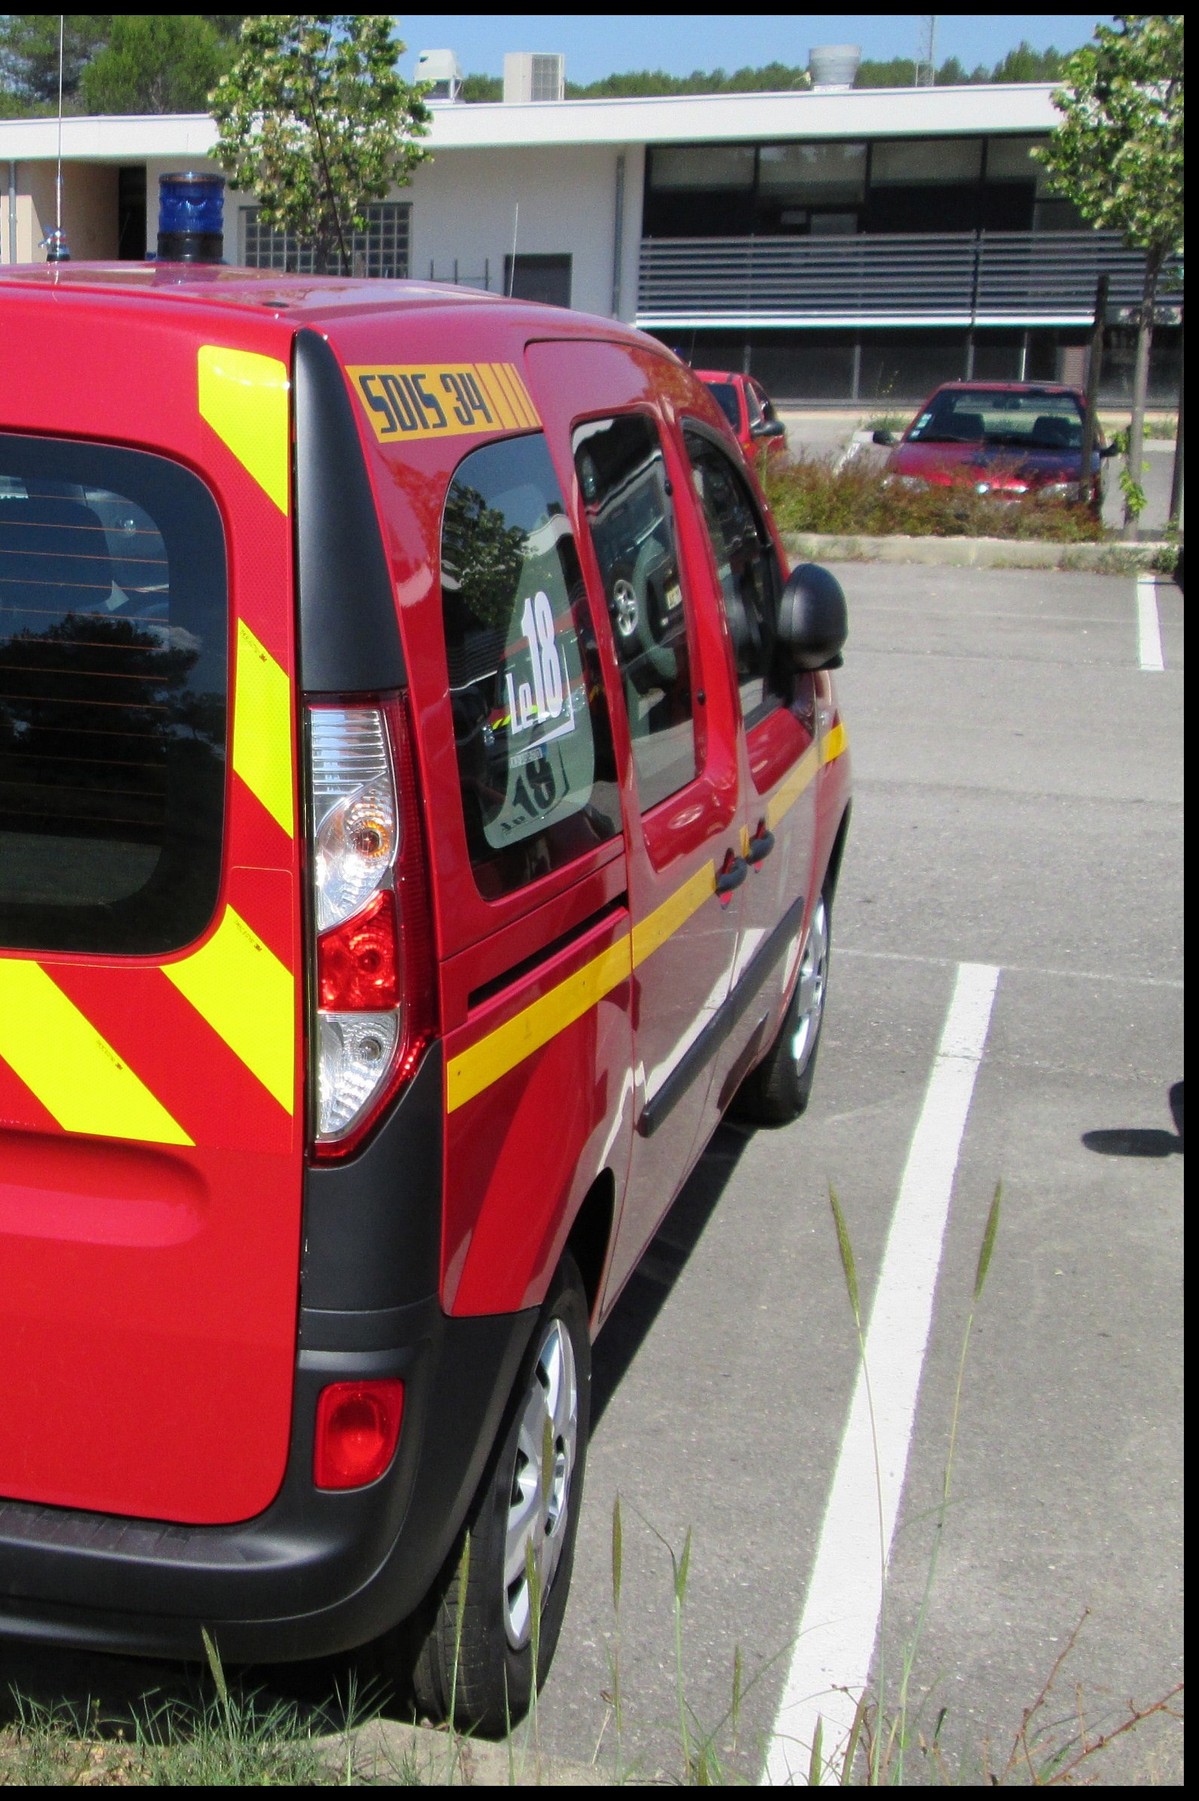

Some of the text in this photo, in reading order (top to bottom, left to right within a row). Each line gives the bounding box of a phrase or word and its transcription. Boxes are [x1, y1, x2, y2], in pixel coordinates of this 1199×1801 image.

[358, 372, 493, 433] SDIS 34
[506, 673, 533, 735] Le
[521, 591, 563, 723] 18
